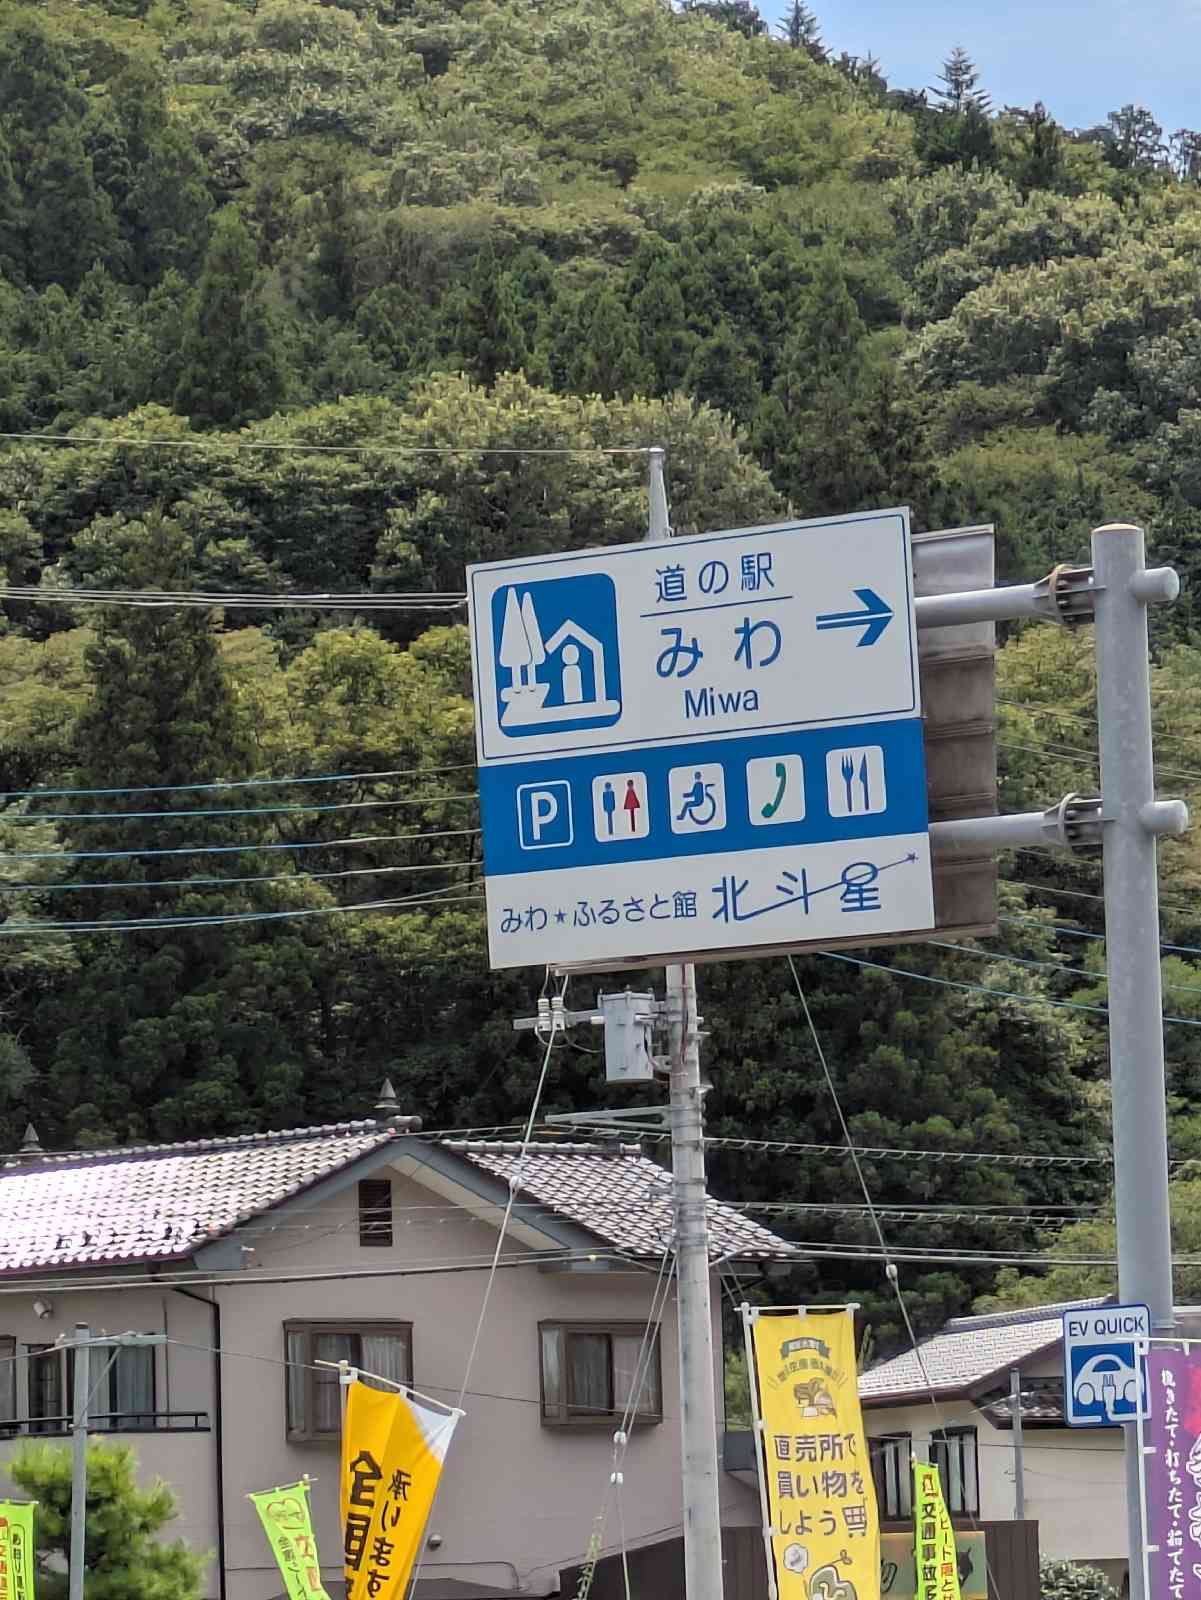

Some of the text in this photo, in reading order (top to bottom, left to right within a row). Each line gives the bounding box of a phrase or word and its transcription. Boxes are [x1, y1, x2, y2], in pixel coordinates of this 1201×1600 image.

[655, 552, 775, 603] 道の駅
[656, 616, 782, 678] みわ
[684, 686, 760, 718] Miwa
[530, 791, 558, 841] P
[712, 862, 882, 923] 北斗星
[1068, 1316, 1144, 1337] EV QUICK
[773, 1433, 857, 1462] 直売所で
[777, 1470, 864, 1499] 買い物を
